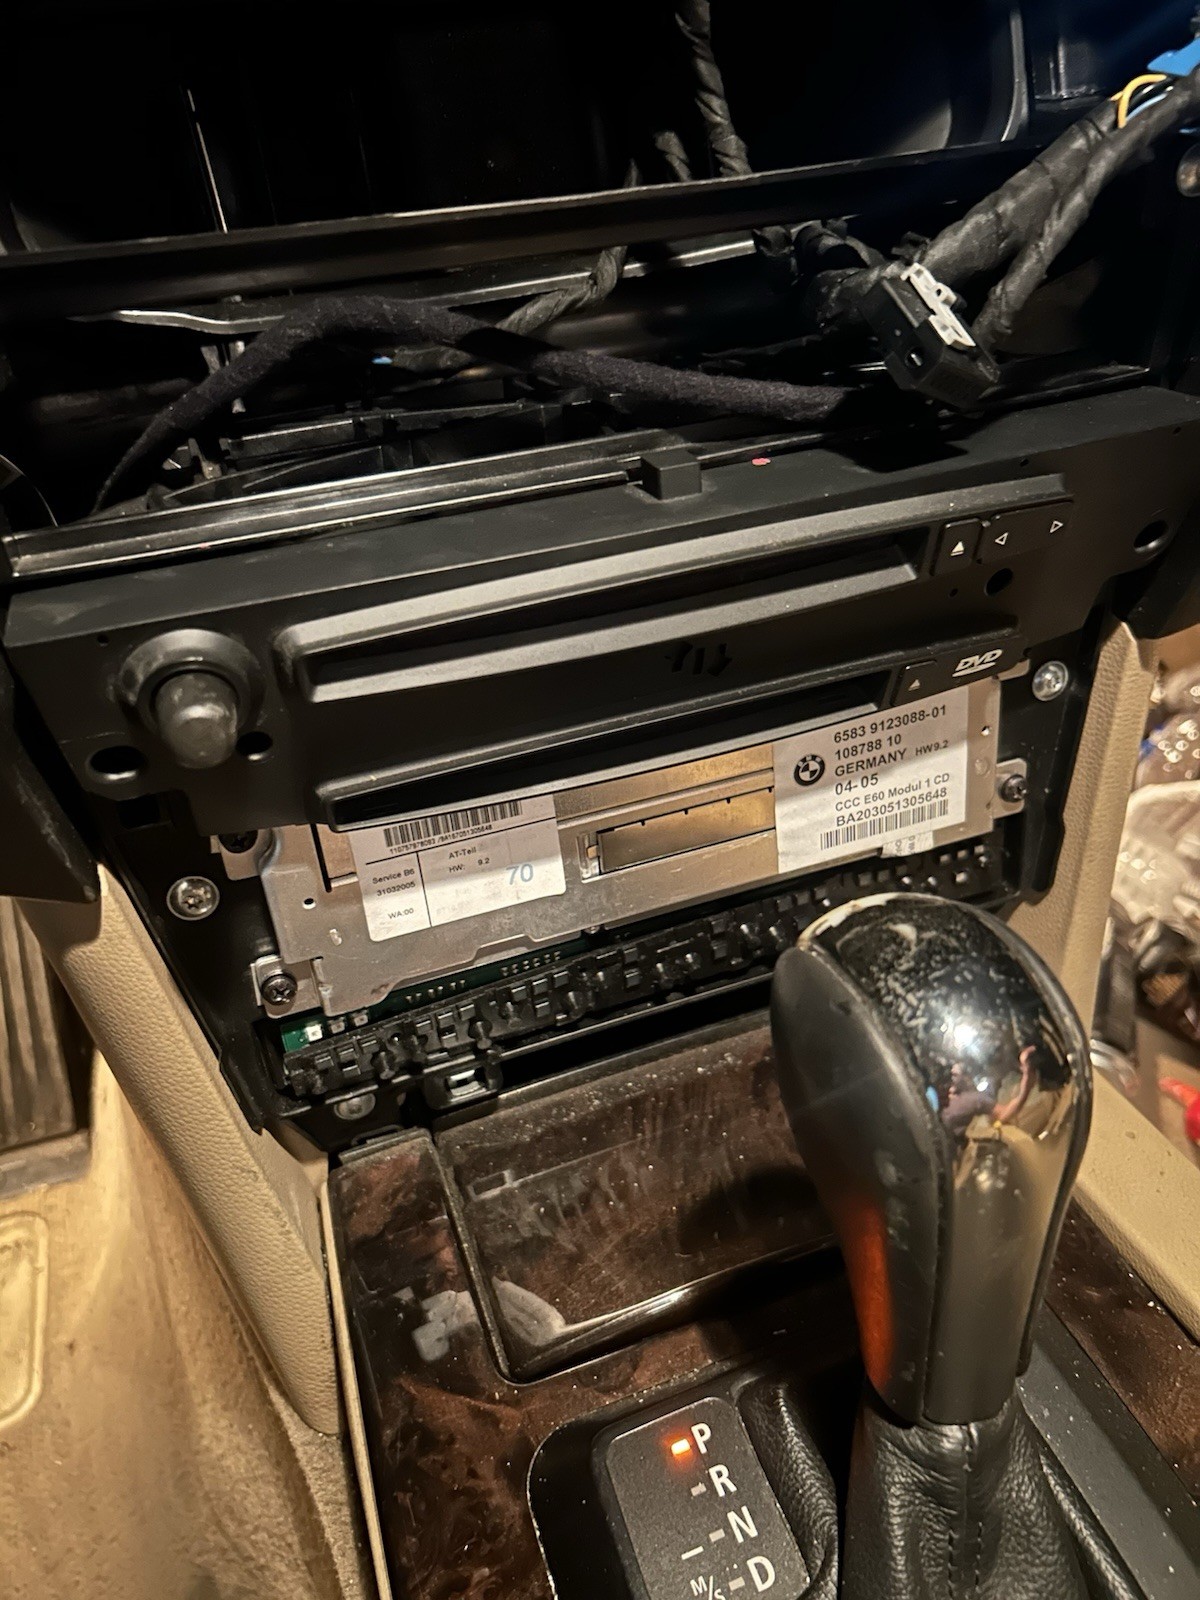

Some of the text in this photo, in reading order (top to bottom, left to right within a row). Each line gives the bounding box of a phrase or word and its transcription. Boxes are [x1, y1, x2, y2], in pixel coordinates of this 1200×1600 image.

[955, 648, 1003, 671] DVD
[834, 705, 946, 743] 6583 9123088-01
[835, 734, 902, 761] 108788 10
[835, 748, 907, 777] GERMANY
[835, 773, 950, 812] CCC E60 Modul 1 CD
[836, 787, 947, 827] BA203051305648
[478, 857, 490, 866] 9.2
[506, 863, 535, 886] 70
[372, 873, 401, 885] Service
[377, 881, 416, 897] 31032005
[691, 1422, 712, 1454] P
[709, 1464, 737, 1497] R
[727, 1505, 758, 1543] N
[746, 1555, 776, 1592] D
